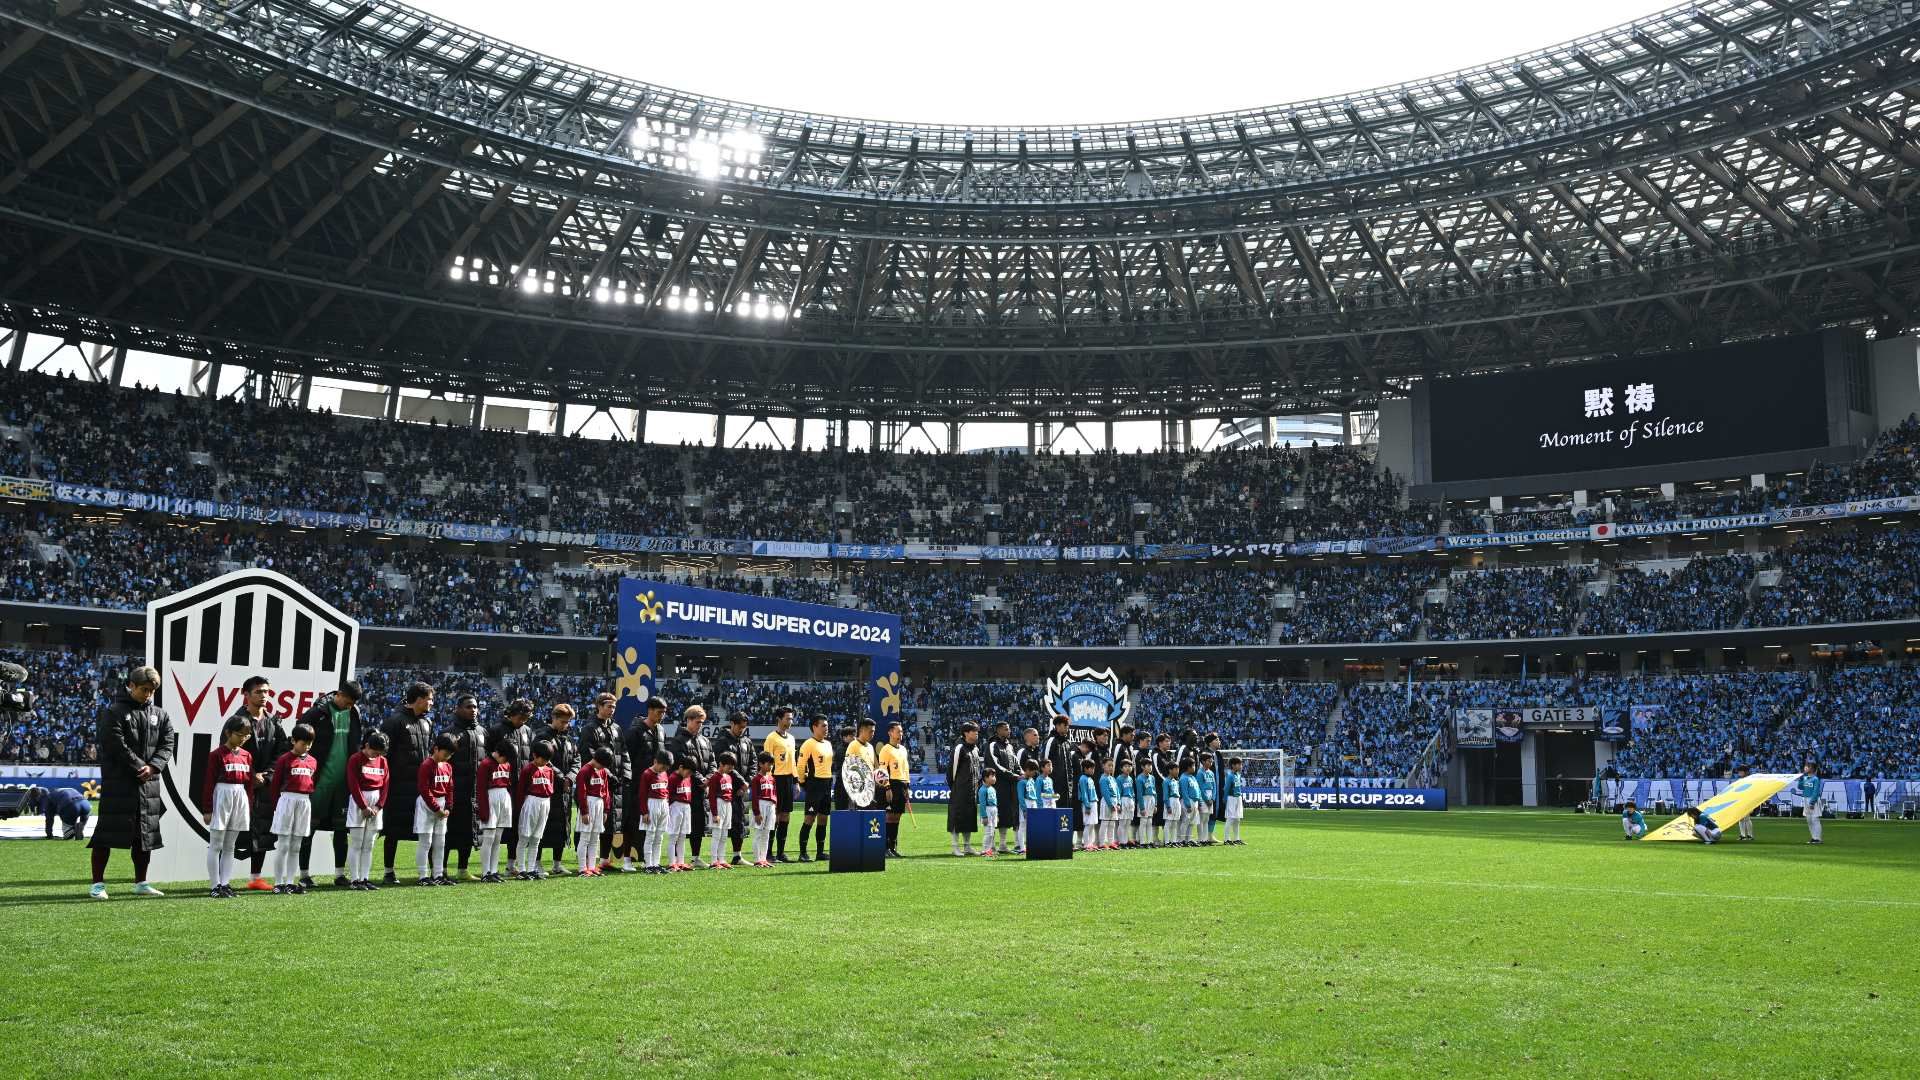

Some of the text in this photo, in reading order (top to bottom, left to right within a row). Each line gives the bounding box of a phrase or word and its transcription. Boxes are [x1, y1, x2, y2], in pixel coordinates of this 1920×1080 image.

[1539, 416, 1705, 449] Moment of Silence
[1616, 514, 1767, 537] KAWASAKI FRONTALE
[1448, 527, 1590, 547] We're in this together
[998, 547, 1043, 560] DAIYA
[666, 601, 891, 644] FUJIFILM SUPER CUP 2024
[1070, 684, 1106, 697] FRONTALE
[217, 686, 329, 721] VSSE
[1531, 709, 1572, 722] GATE
[1576, 709, 1585, 721] 3
[914, 790, 938, 800] CUP
[1298, 793, 1348, 805] SUPER
[1350, 793, 1383, 804] CUP
[1385, 793, 1425, 805] 2024
